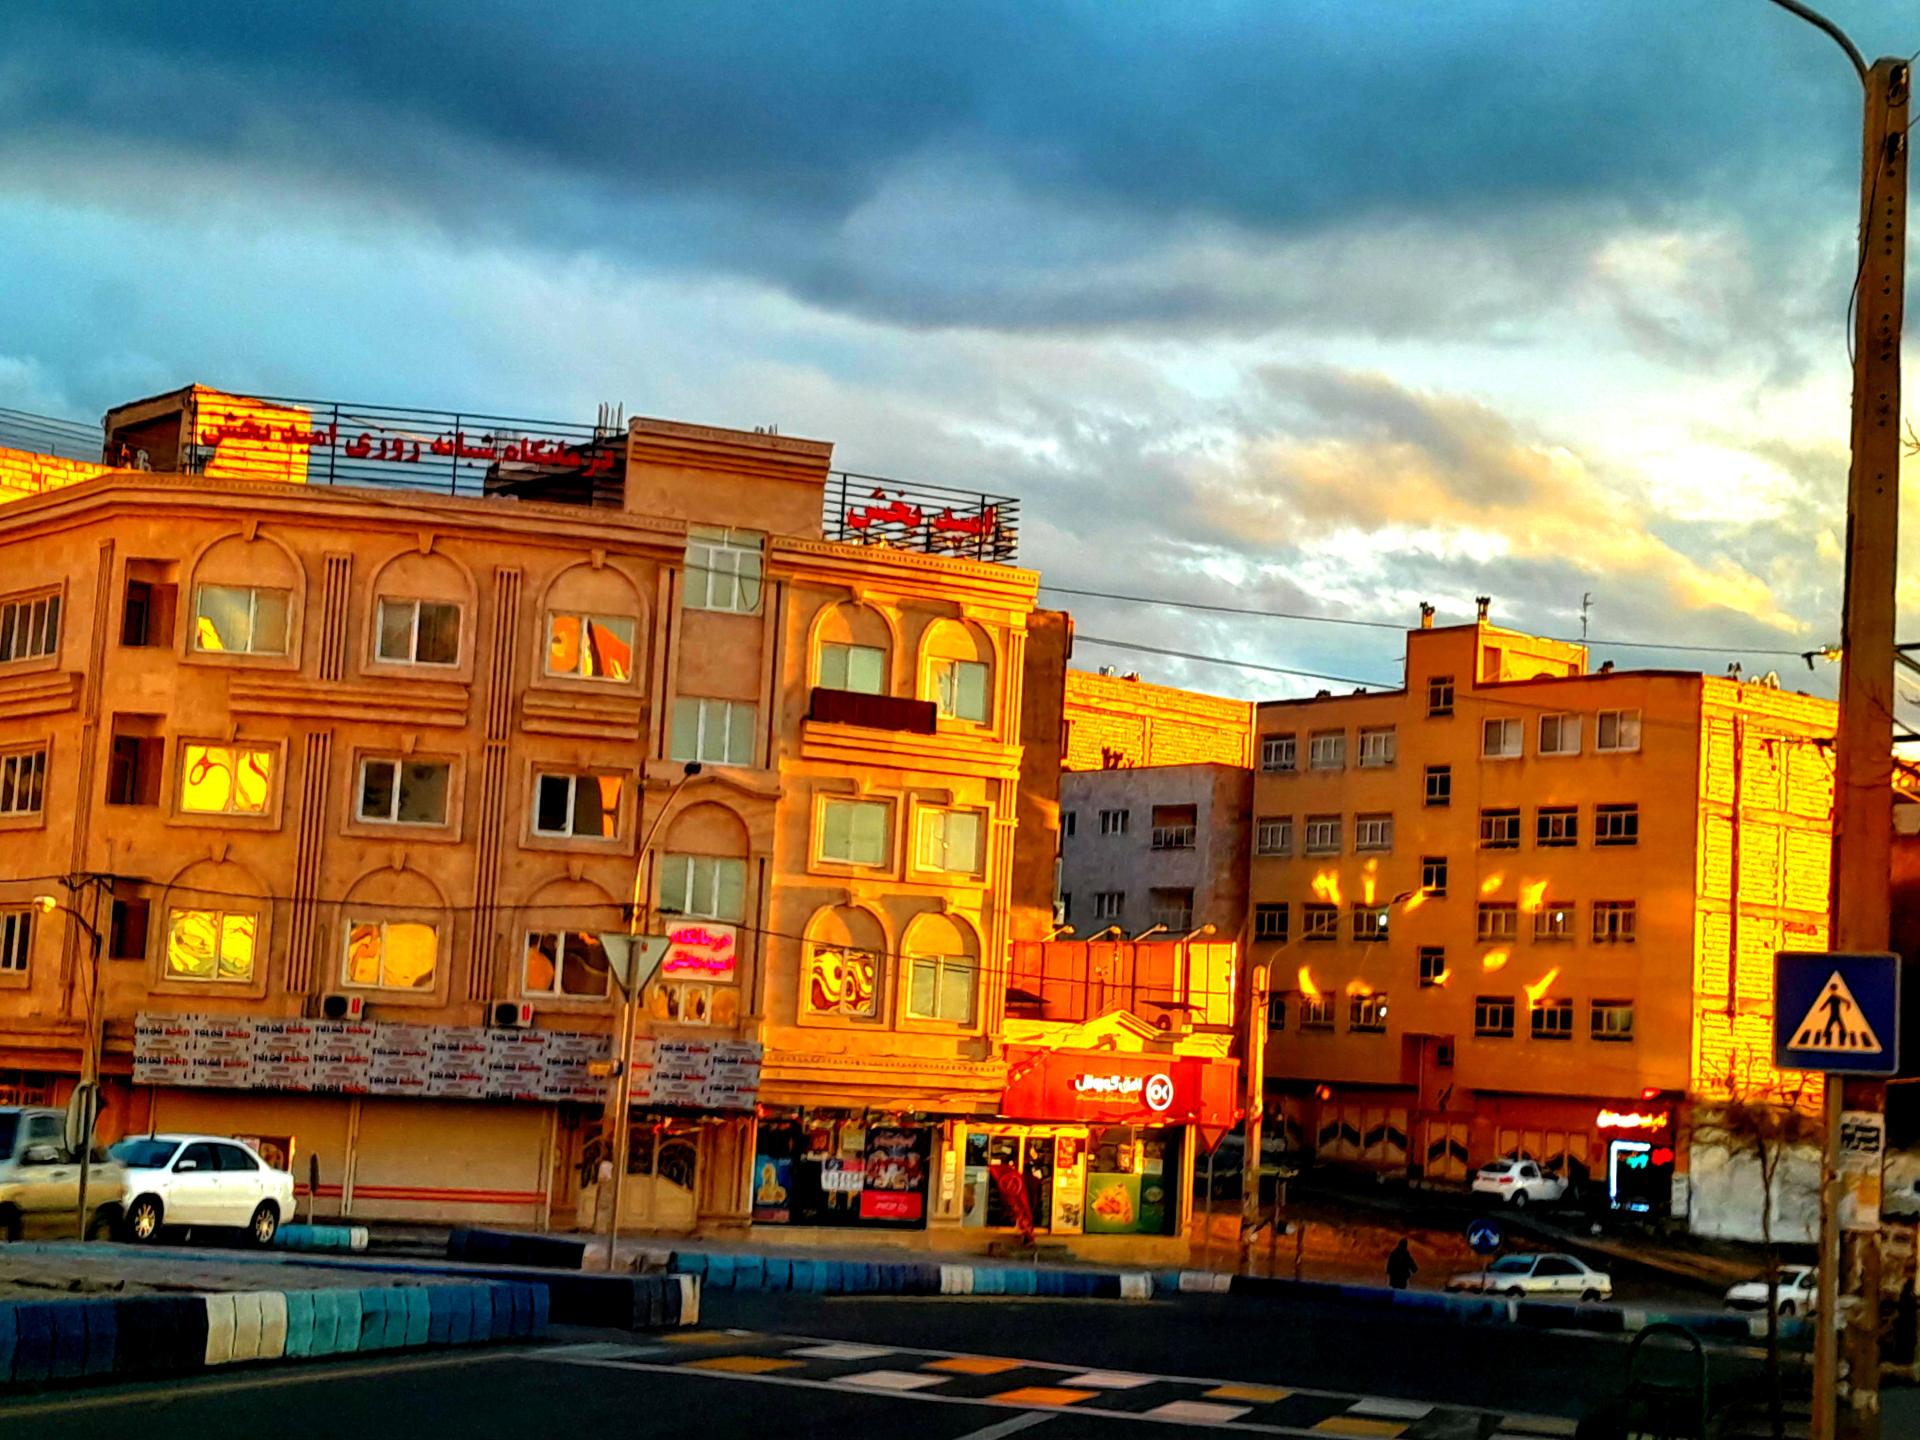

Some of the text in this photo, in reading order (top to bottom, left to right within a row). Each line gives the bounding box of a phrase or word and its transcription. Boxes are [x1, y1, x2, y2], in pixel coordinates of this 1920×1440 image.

[344, 428, 421, 463] روزی
[430, 430, 498, 469] شبانه
[503, 436, 616, 478] درمانگاه
